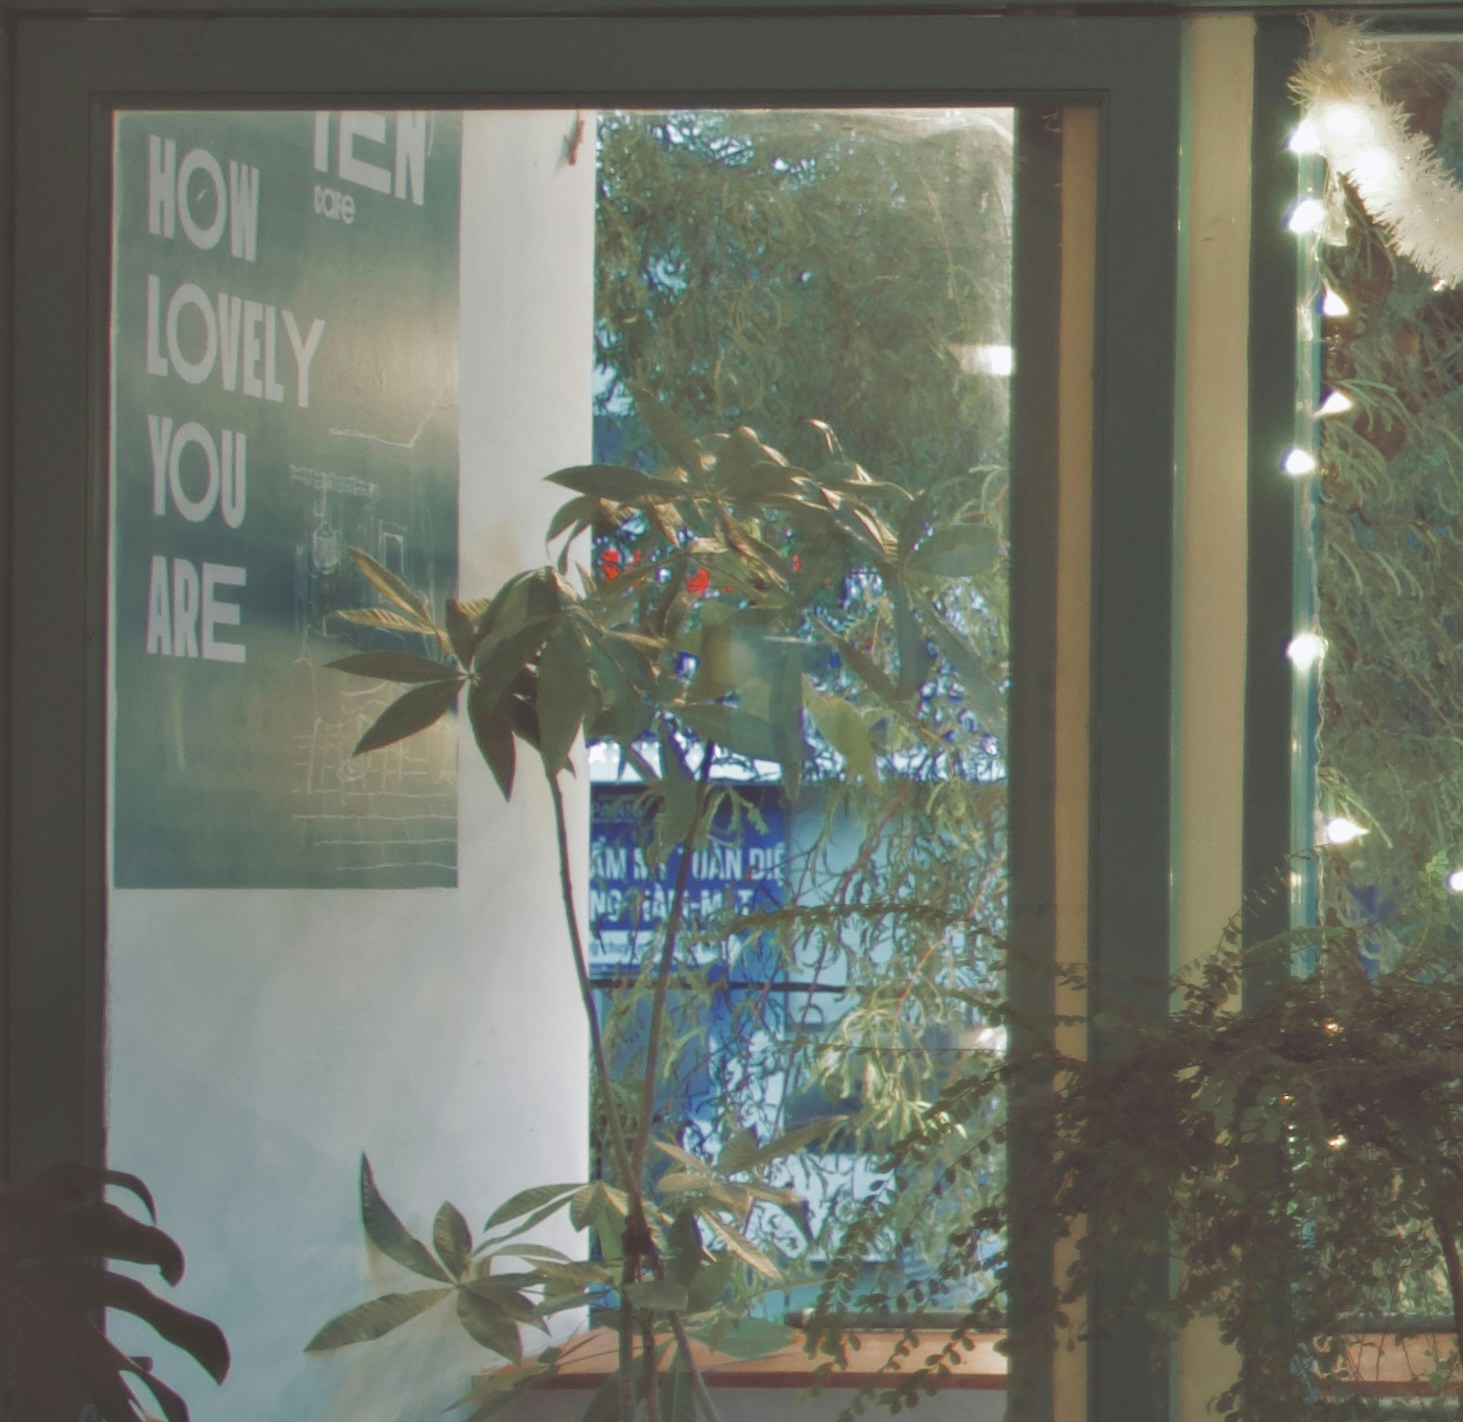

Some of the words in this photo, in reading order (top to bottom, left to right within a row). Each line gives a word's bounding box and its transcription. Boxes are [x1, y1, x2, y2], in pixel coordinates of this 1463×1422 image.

[147, 135, 260, 263] HOW
[146, 274, 325, 409] LOVELY
[146, 413, 247, 529] YOU
[146, 555, 247, 664] ARE
